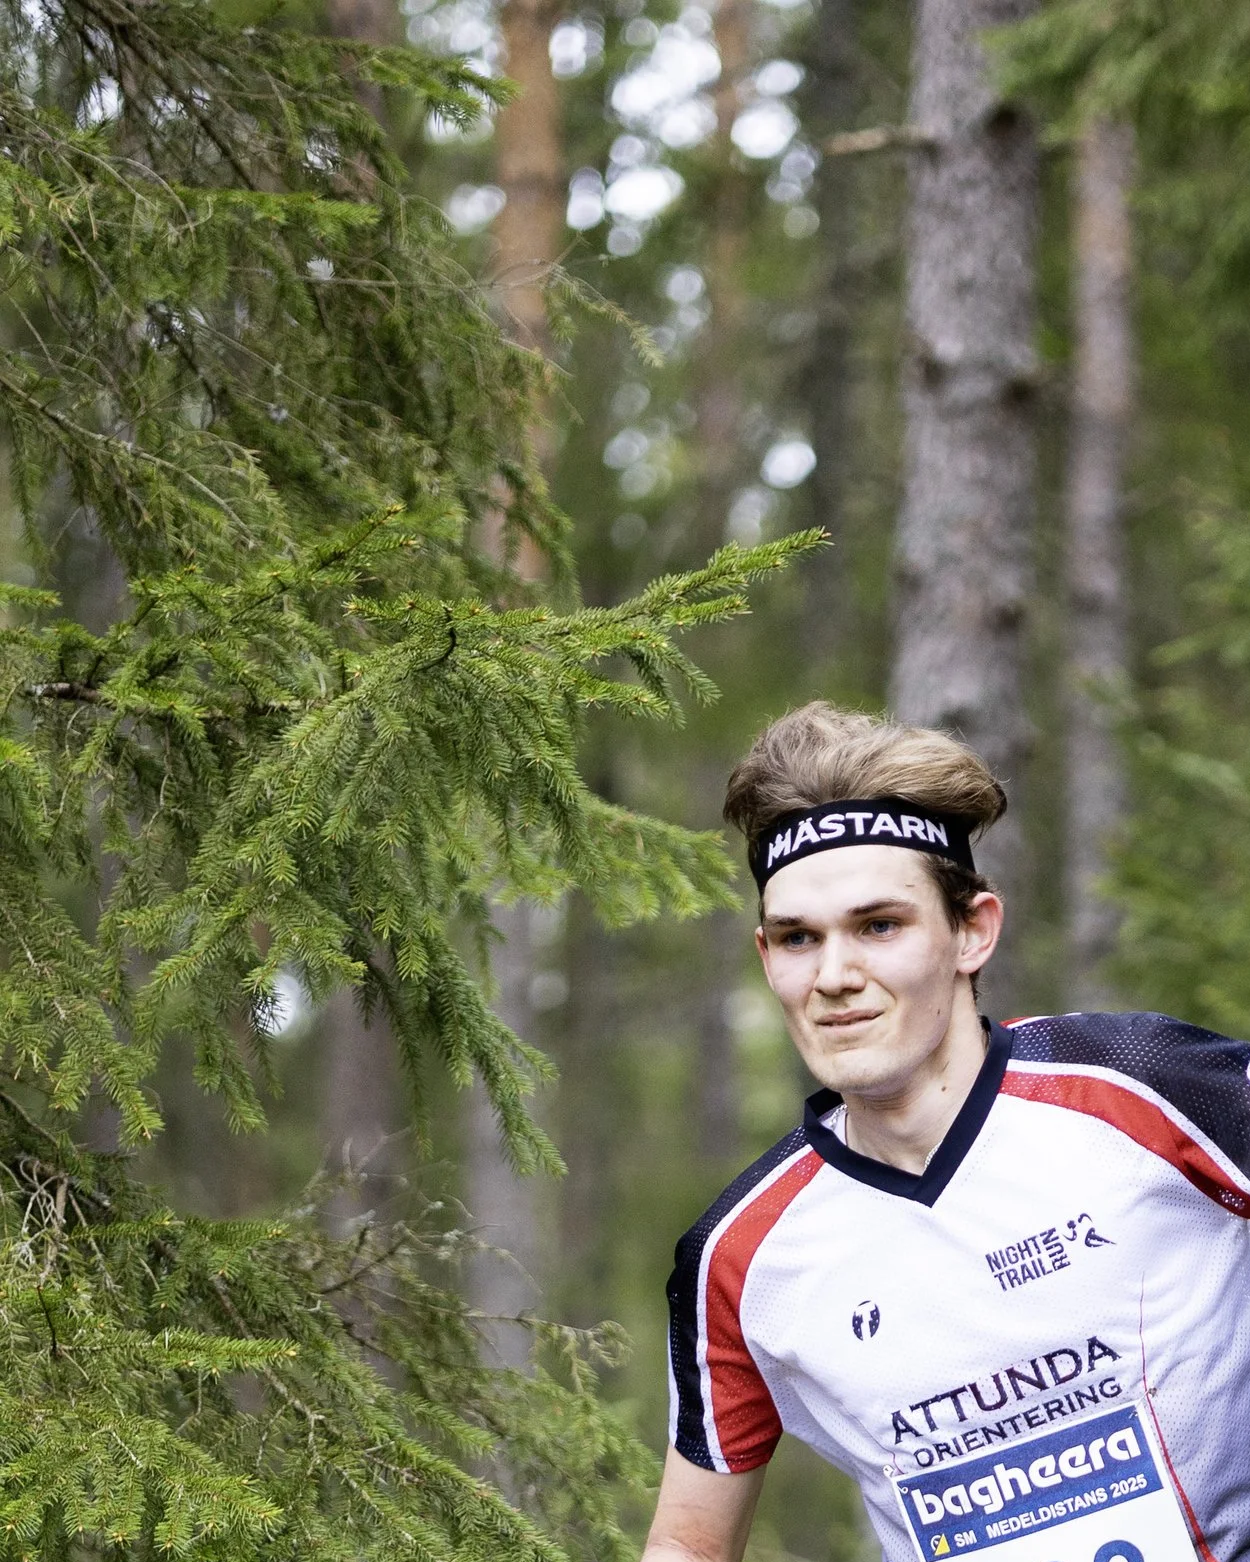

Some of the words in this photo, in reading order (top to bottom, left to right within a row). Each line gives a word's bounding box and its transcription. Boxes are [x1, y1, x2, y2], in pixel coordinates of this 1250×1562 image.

[767, 812, 949, 868] MÄSTARN
[985, 1234, 1045, 1273] NIGHT
[994, 1256, 1052, 1292] TRAIL
[1042, 1227, 1071, 1271] RUN
[891, 1335, 1122, 1445] ATTUNDA
[913, 1376, 1123, 1468] ORIENTERING
[911, 1426, 1142, 1526] bagheera
[953, 1529, 978, 1548] SM
[985, 1486, 1108, 1540] MEDELDISTANS
[1111, 1473, 1148, 1499] 2025
